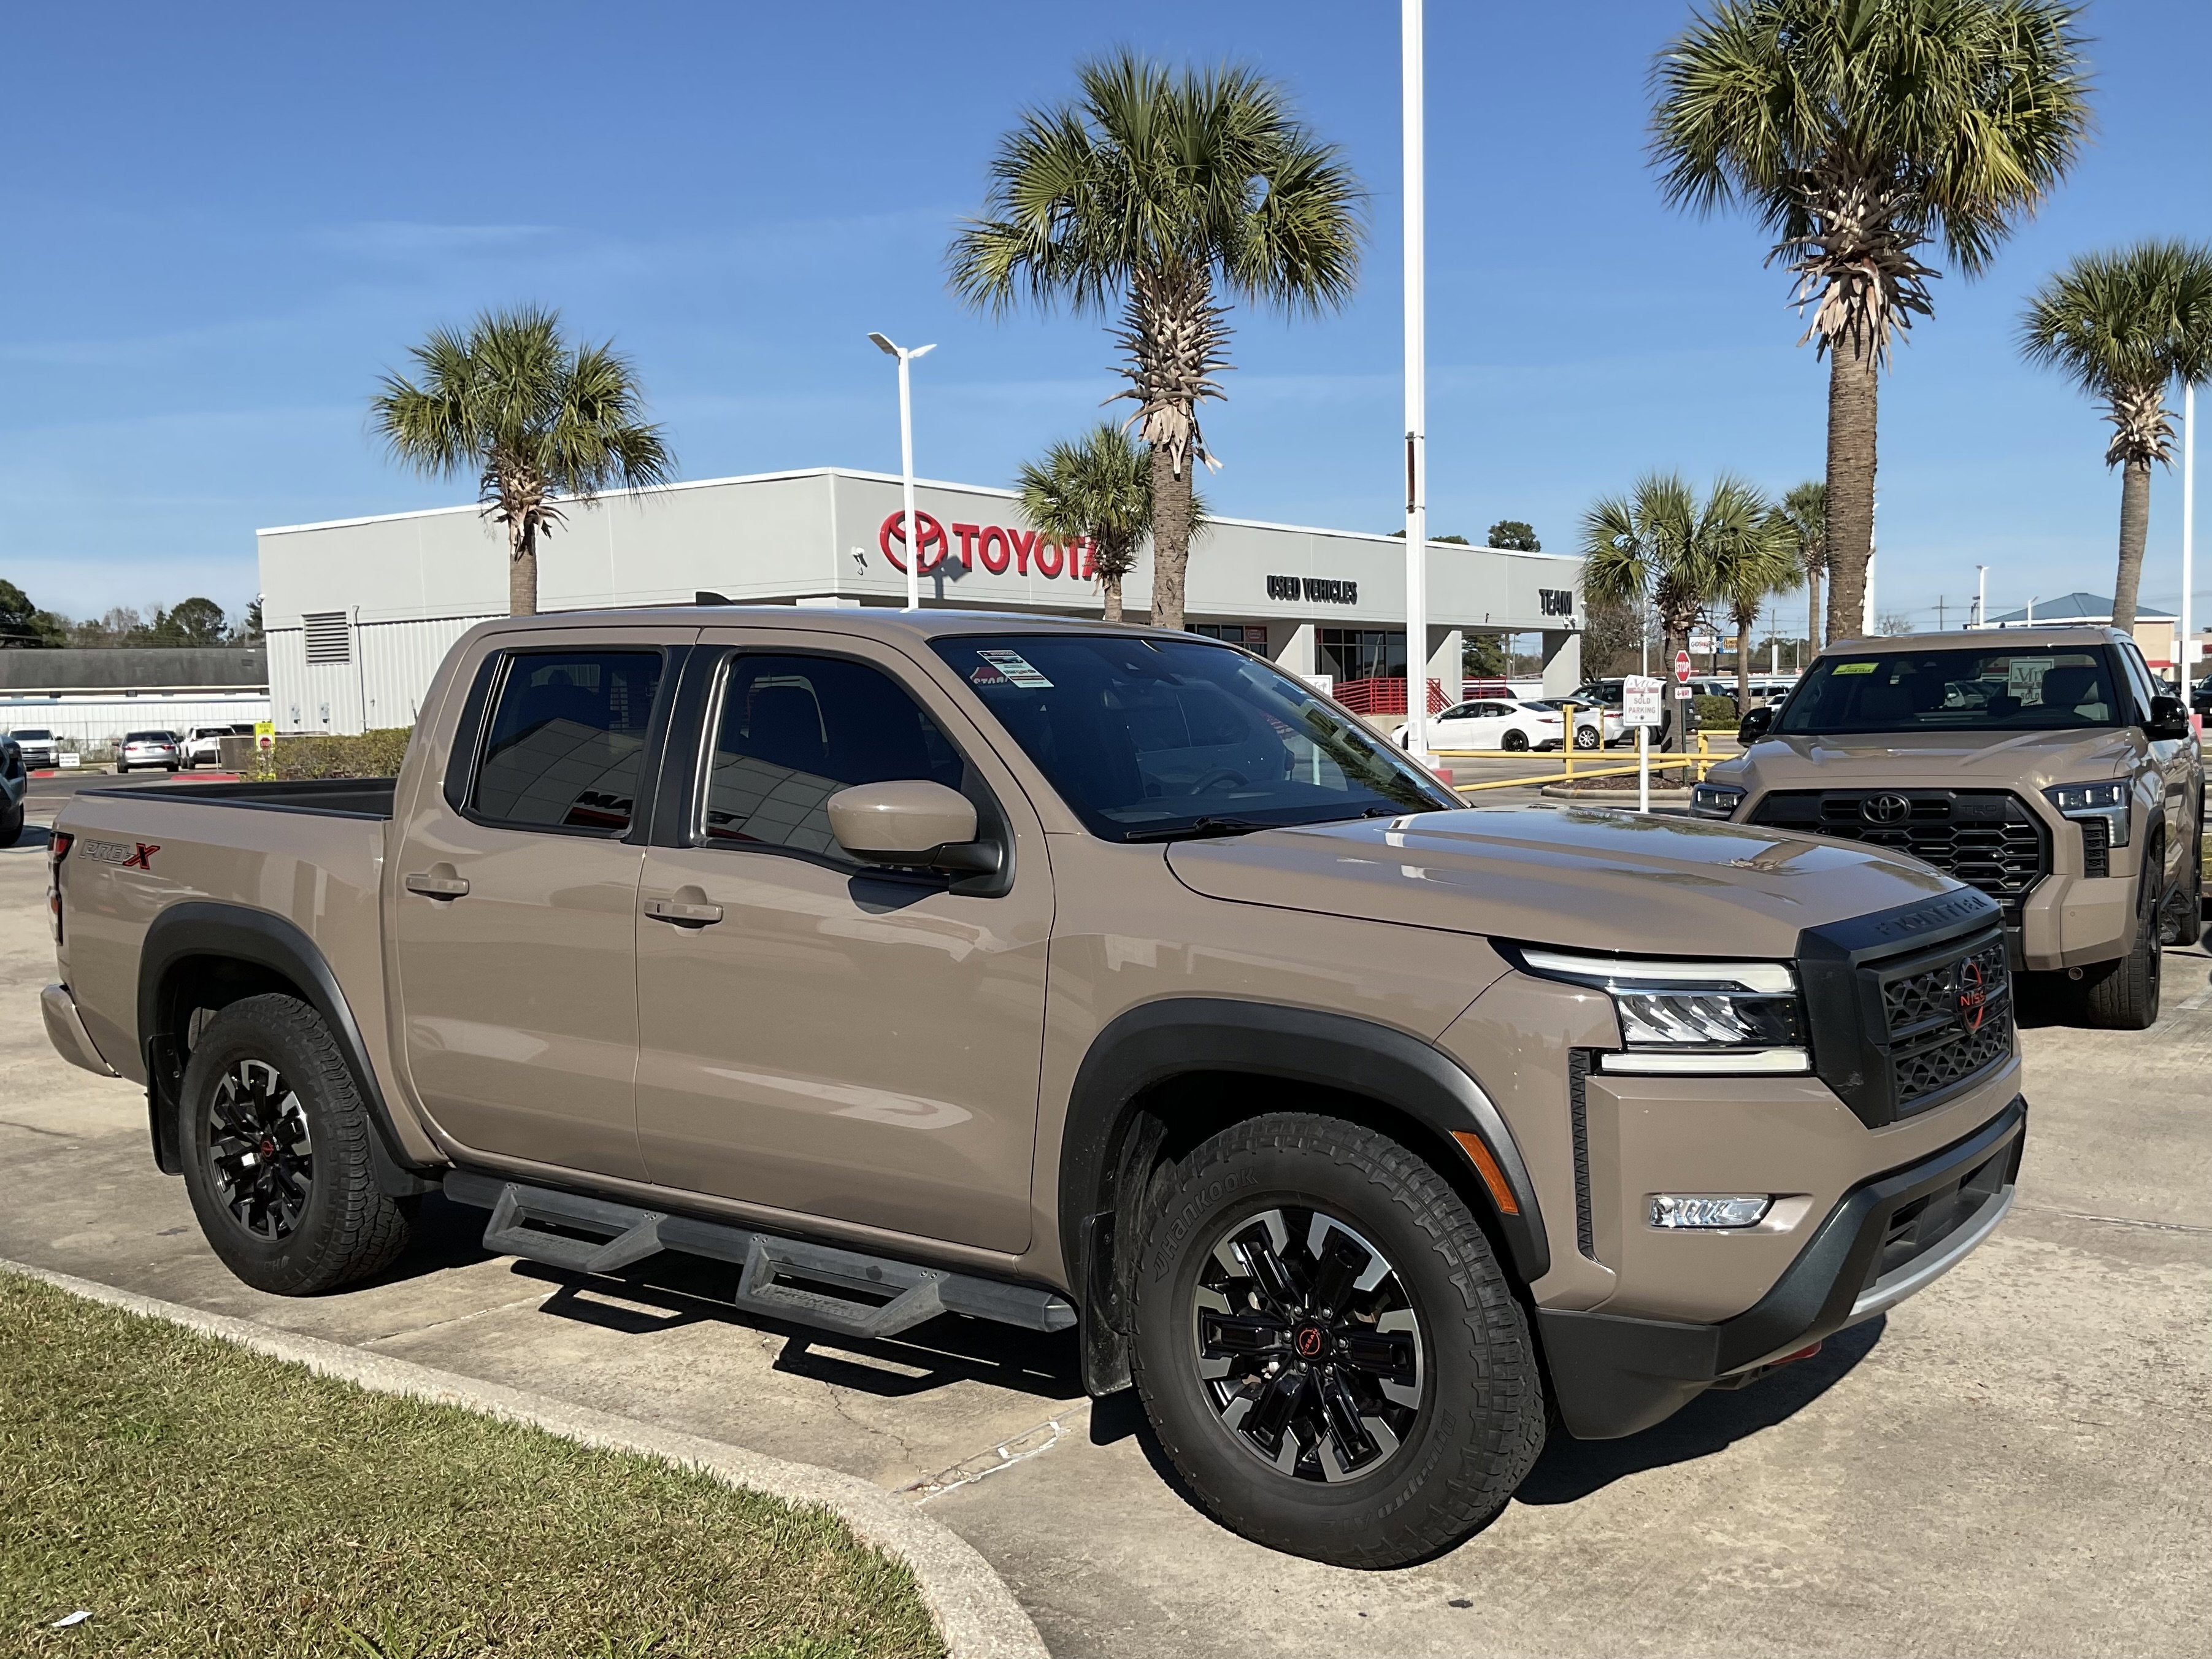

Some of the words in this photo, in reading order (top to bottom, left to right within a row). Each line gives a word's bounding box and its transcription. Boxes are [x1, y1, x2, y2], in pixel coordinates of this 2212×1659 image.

[1267, 575, 1300, 601] USED
[1302, 578, 1358, 605] VEHICLES
[1538, 589, 1572, 616] TEAM
[1676, 662, 1689, 672] STOP
[1302, 1328, 1318, 1355] NISSAN
